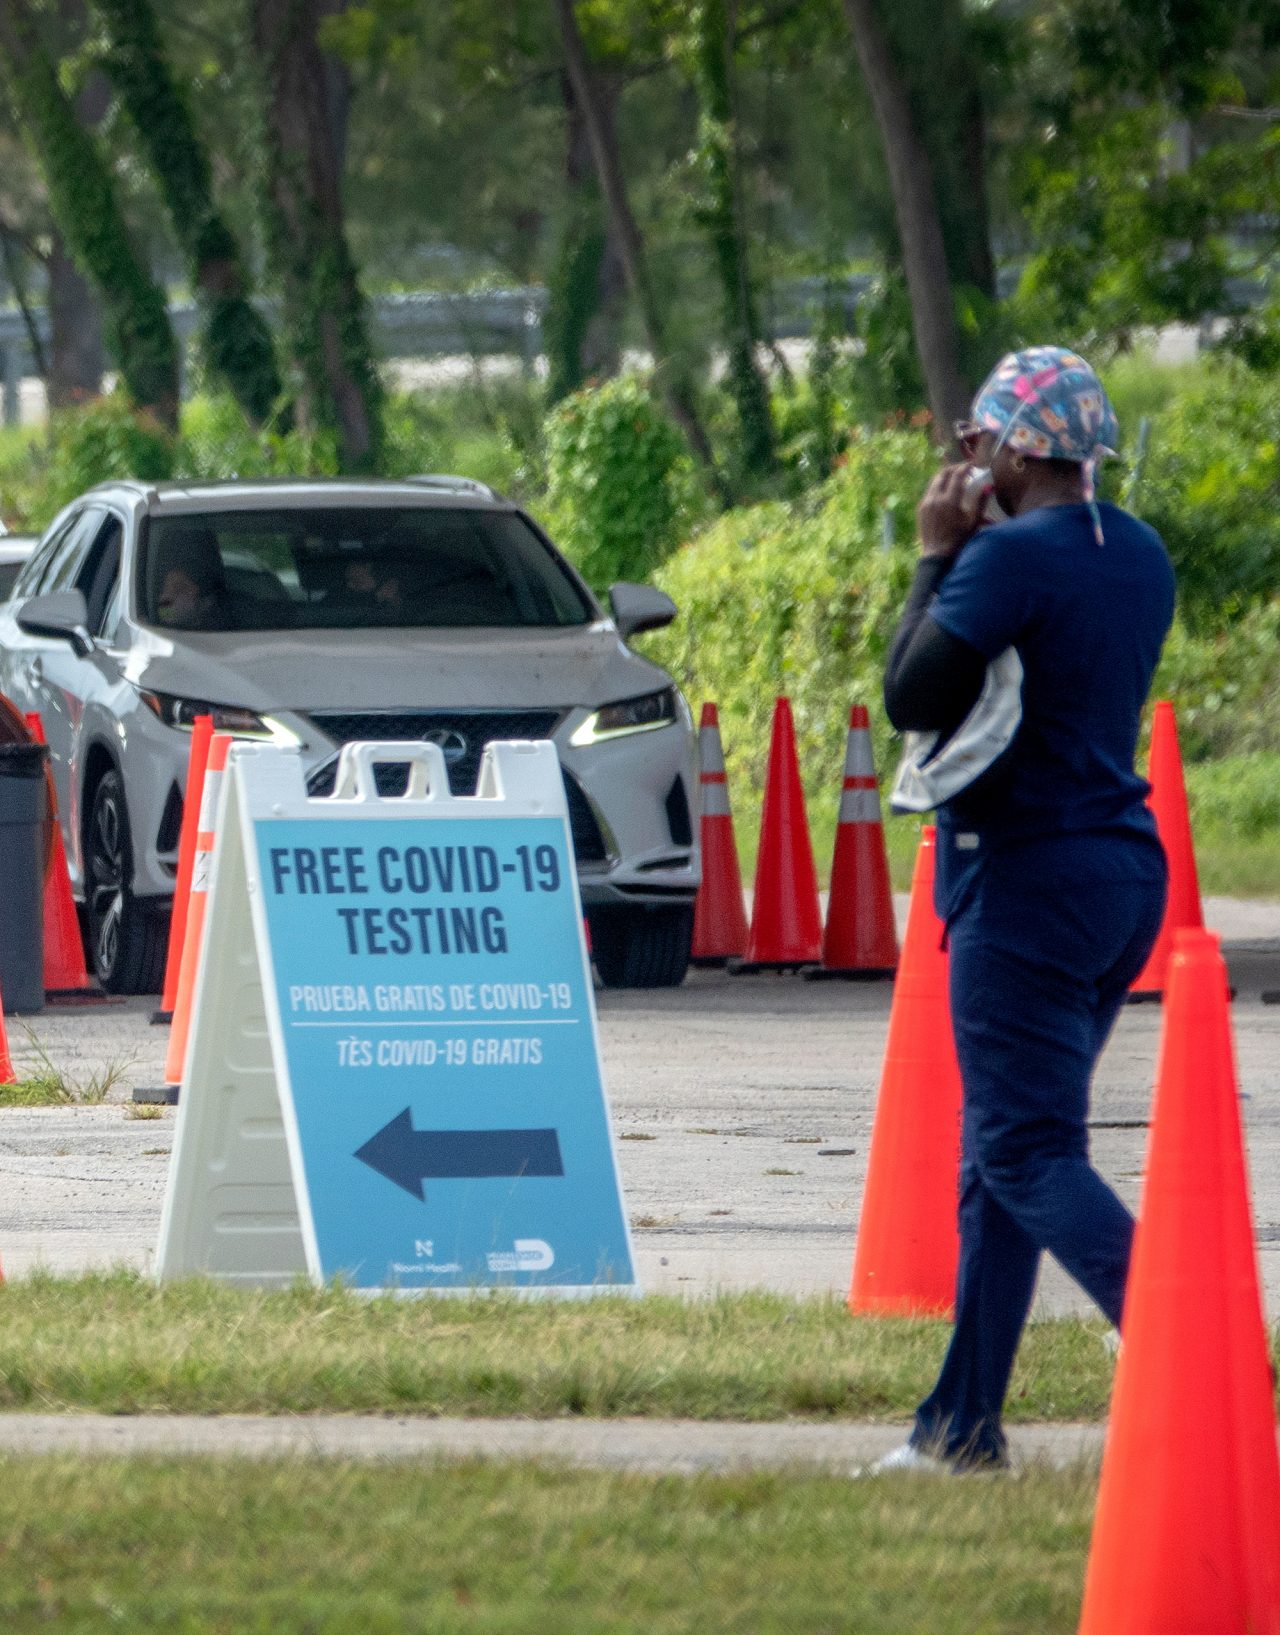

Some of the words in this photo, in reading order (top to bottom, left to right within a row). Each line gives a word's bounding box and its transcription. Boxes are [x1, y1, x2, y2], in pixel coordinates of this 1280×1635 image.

[270, 847, 369, 894] FREE
[377, 844, 561, 893] COVID-19
[336, 906, 509, 954] TESTING
[289, 985, 370, 1012] PRUEBA
[375, 984, 445, 1011] GRATIS
[449, 984, 476, 1010] DE
[480, 983, 572, 1010] COVID-19
[337, 1036, 372, 1067] TÈS
[377, 1039, 468, 1067] COVID-19
[472, 1037, 542, 1066] GRATIS
